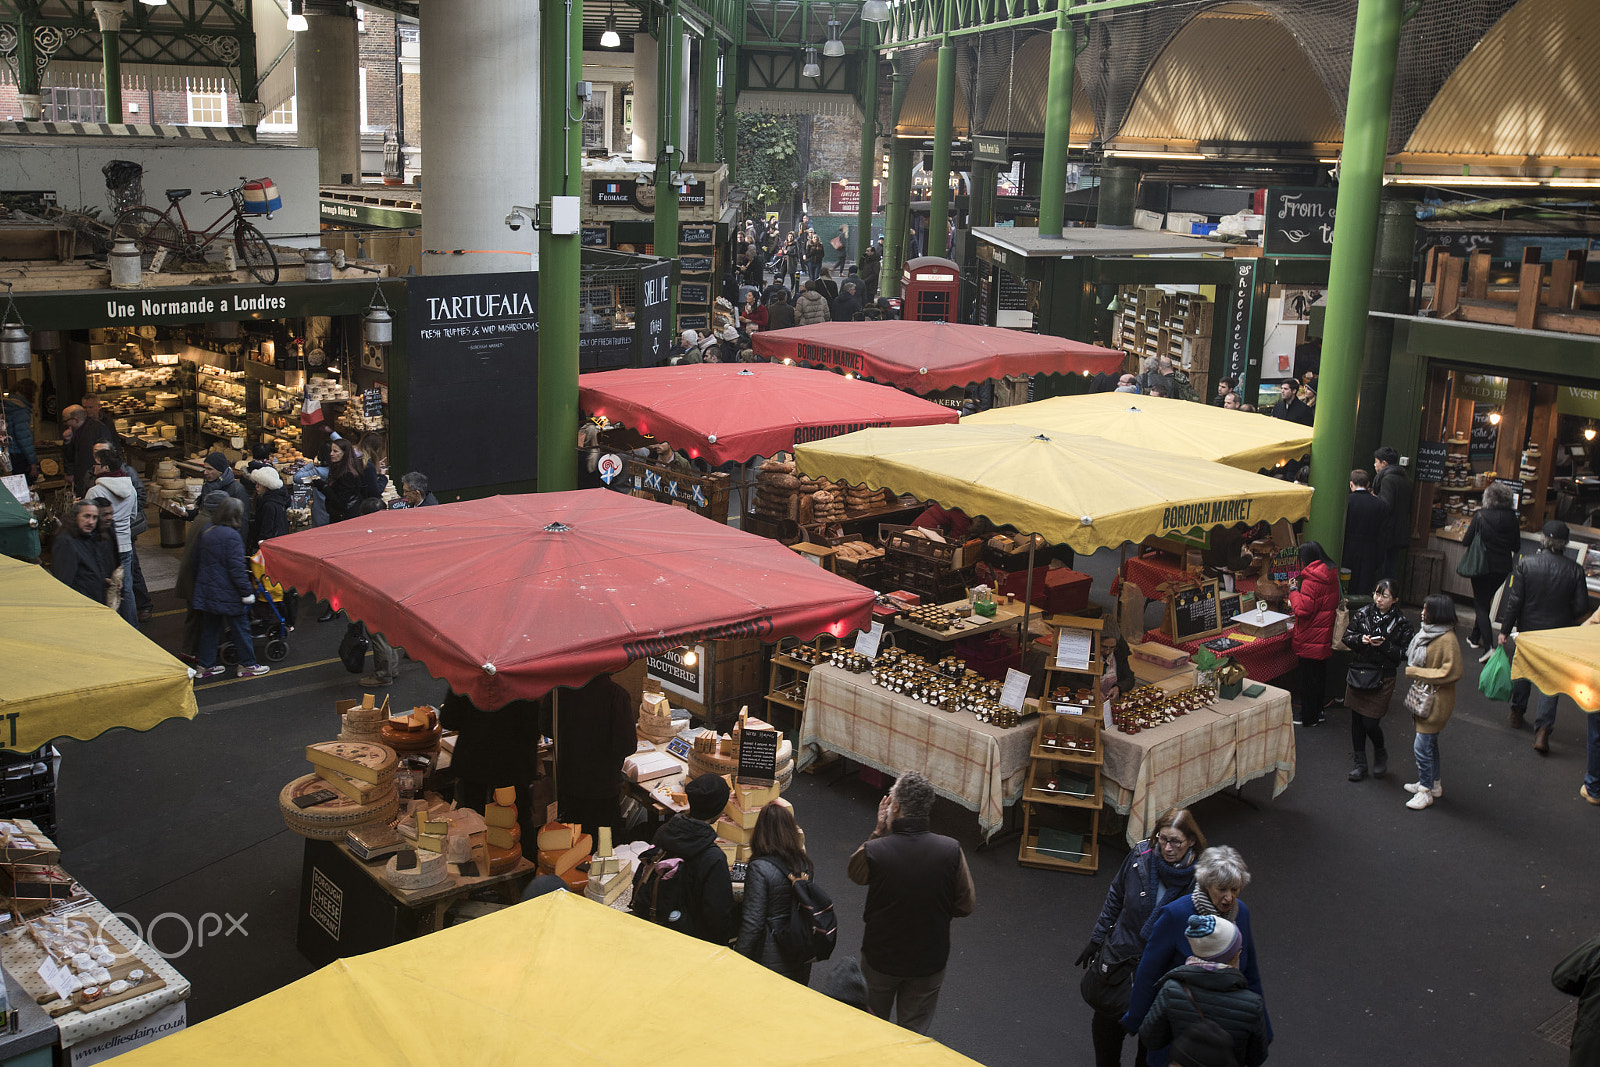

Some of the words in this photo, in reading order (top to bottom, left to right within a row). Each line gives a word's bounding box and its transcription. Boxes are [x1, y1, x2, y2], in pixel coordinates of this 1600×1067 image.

[1278, 192, 1325, 219] From
[107, 301, 135, 318] Une
[142, 297, 214, 316] Normande
[220, 300, 228, 311] a
[234, 294, 286, 311] Londres
[426, 293, 534, 320] TARTUFAIA
[420, 329, 441, 339] FRESH
[443, 327, 471, 338] TRUFFLES
[472, 326, 480, 336] &
[482, 324, 496, 334] WILD
[498, 321, 540, 333] MUSHROOMS
[797, 343, 832, 364] BOROUGH
[832, 349, 865, 371] MARKET
[928, 398, 962, 406] AKERY
[1460, 385, 1491, 397] WILD
[1493, 390, 1507, 399] BE
[1568, 386, 1598, 400] West
[1162, 503, 1211, 529] BOROUGH
[1210, 498, 1254, 523] MARKET
[647, 657, 696, 684] ARCUTERIE
[314, 872, 341, 903] BOROUGH
[313, 888, 340, 921] CHEESE
[312, 905, 338, 934] COMPANY
[74, 1015, 186, 1061] www.elliesdairy.co.uk
